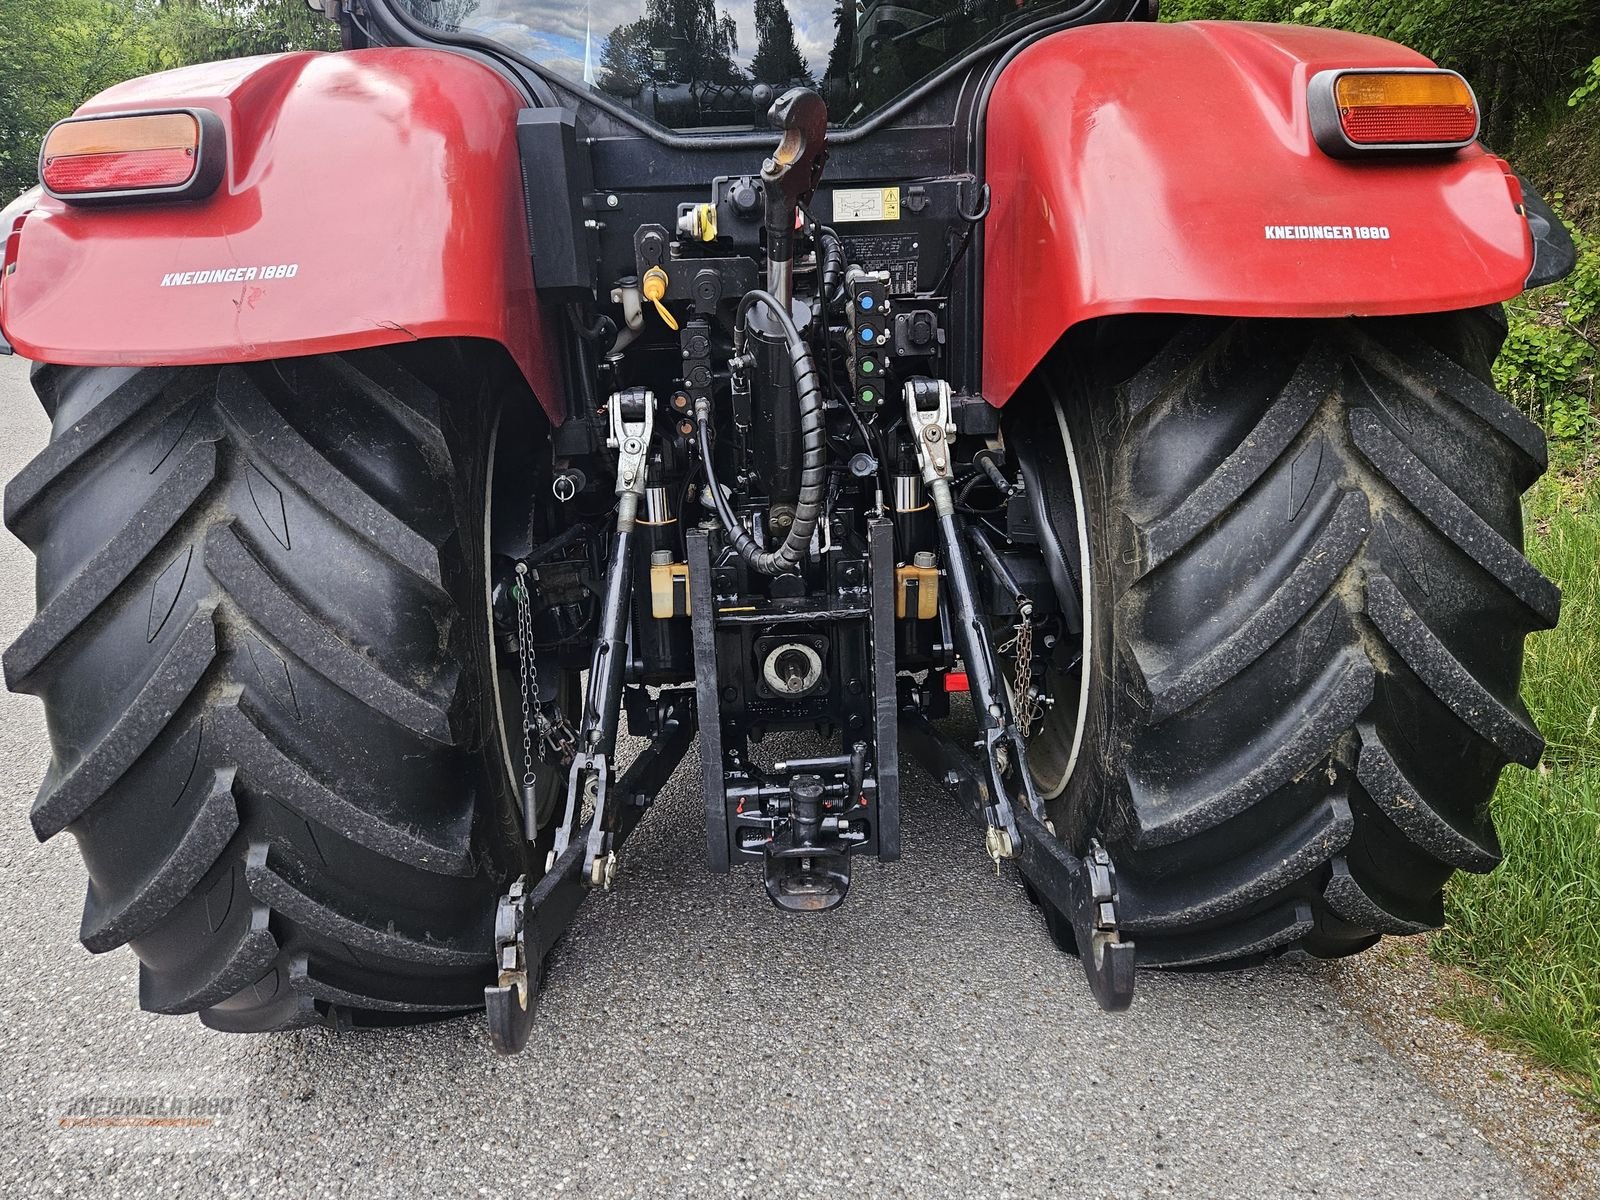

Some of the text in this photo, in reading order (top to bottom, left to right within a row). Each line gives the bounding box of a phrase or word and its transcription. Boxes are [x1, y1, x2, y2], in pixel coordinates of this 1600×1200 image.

[1264, 226, 1390, 239] KNEIDINGER 1880
[160, 264, 298, 287] KNEIDINGER 1880
